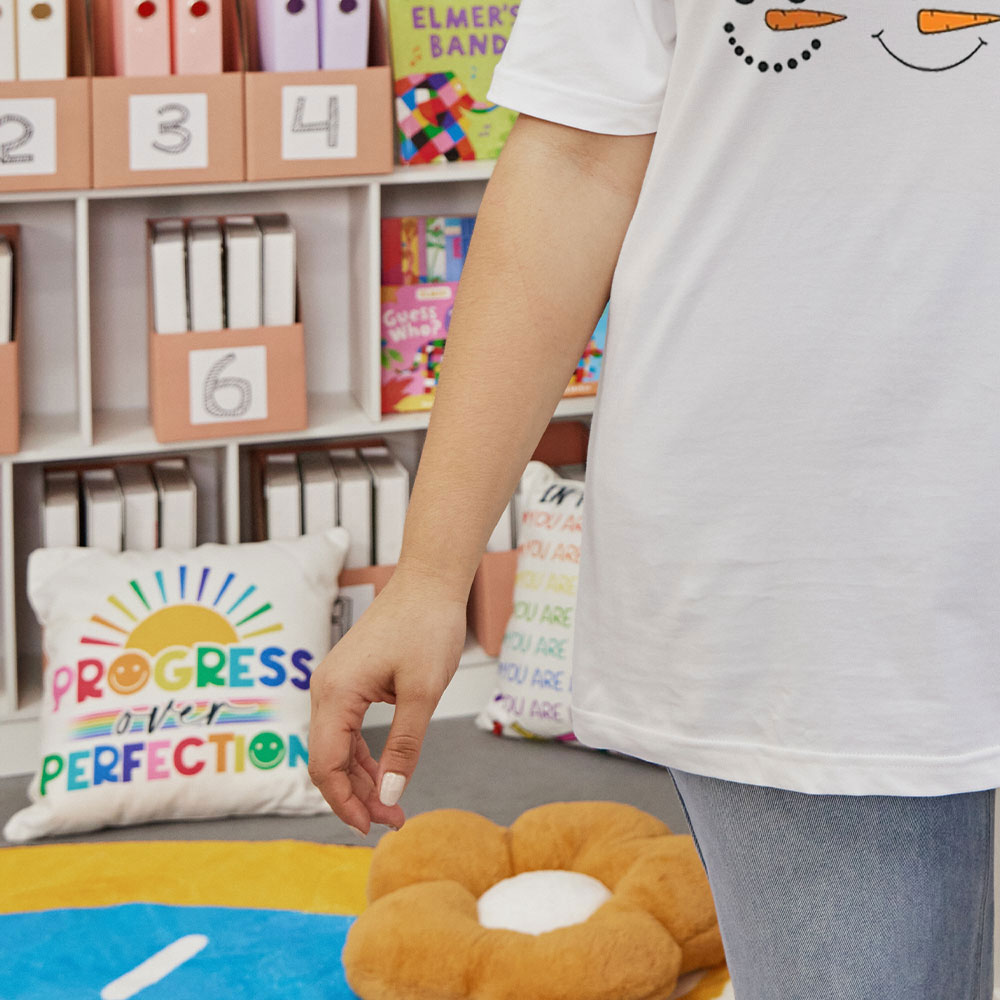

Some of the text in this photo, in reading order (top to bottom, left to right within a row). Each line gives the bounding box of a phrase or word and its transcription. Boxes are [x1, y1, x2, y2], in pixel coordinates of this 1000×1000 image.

[429, 33, 509, 59] BAND
[151, 102, 192, 156] 3
[291, 95, 340, 149] 4
[382, 305, 438, 327] Guess
[388, 319, 443, 344] Who?
[202, 352, 252, 418] 6
[52, 645, 312, 714] PROGRESS
[115, 699, 250, 735] over
